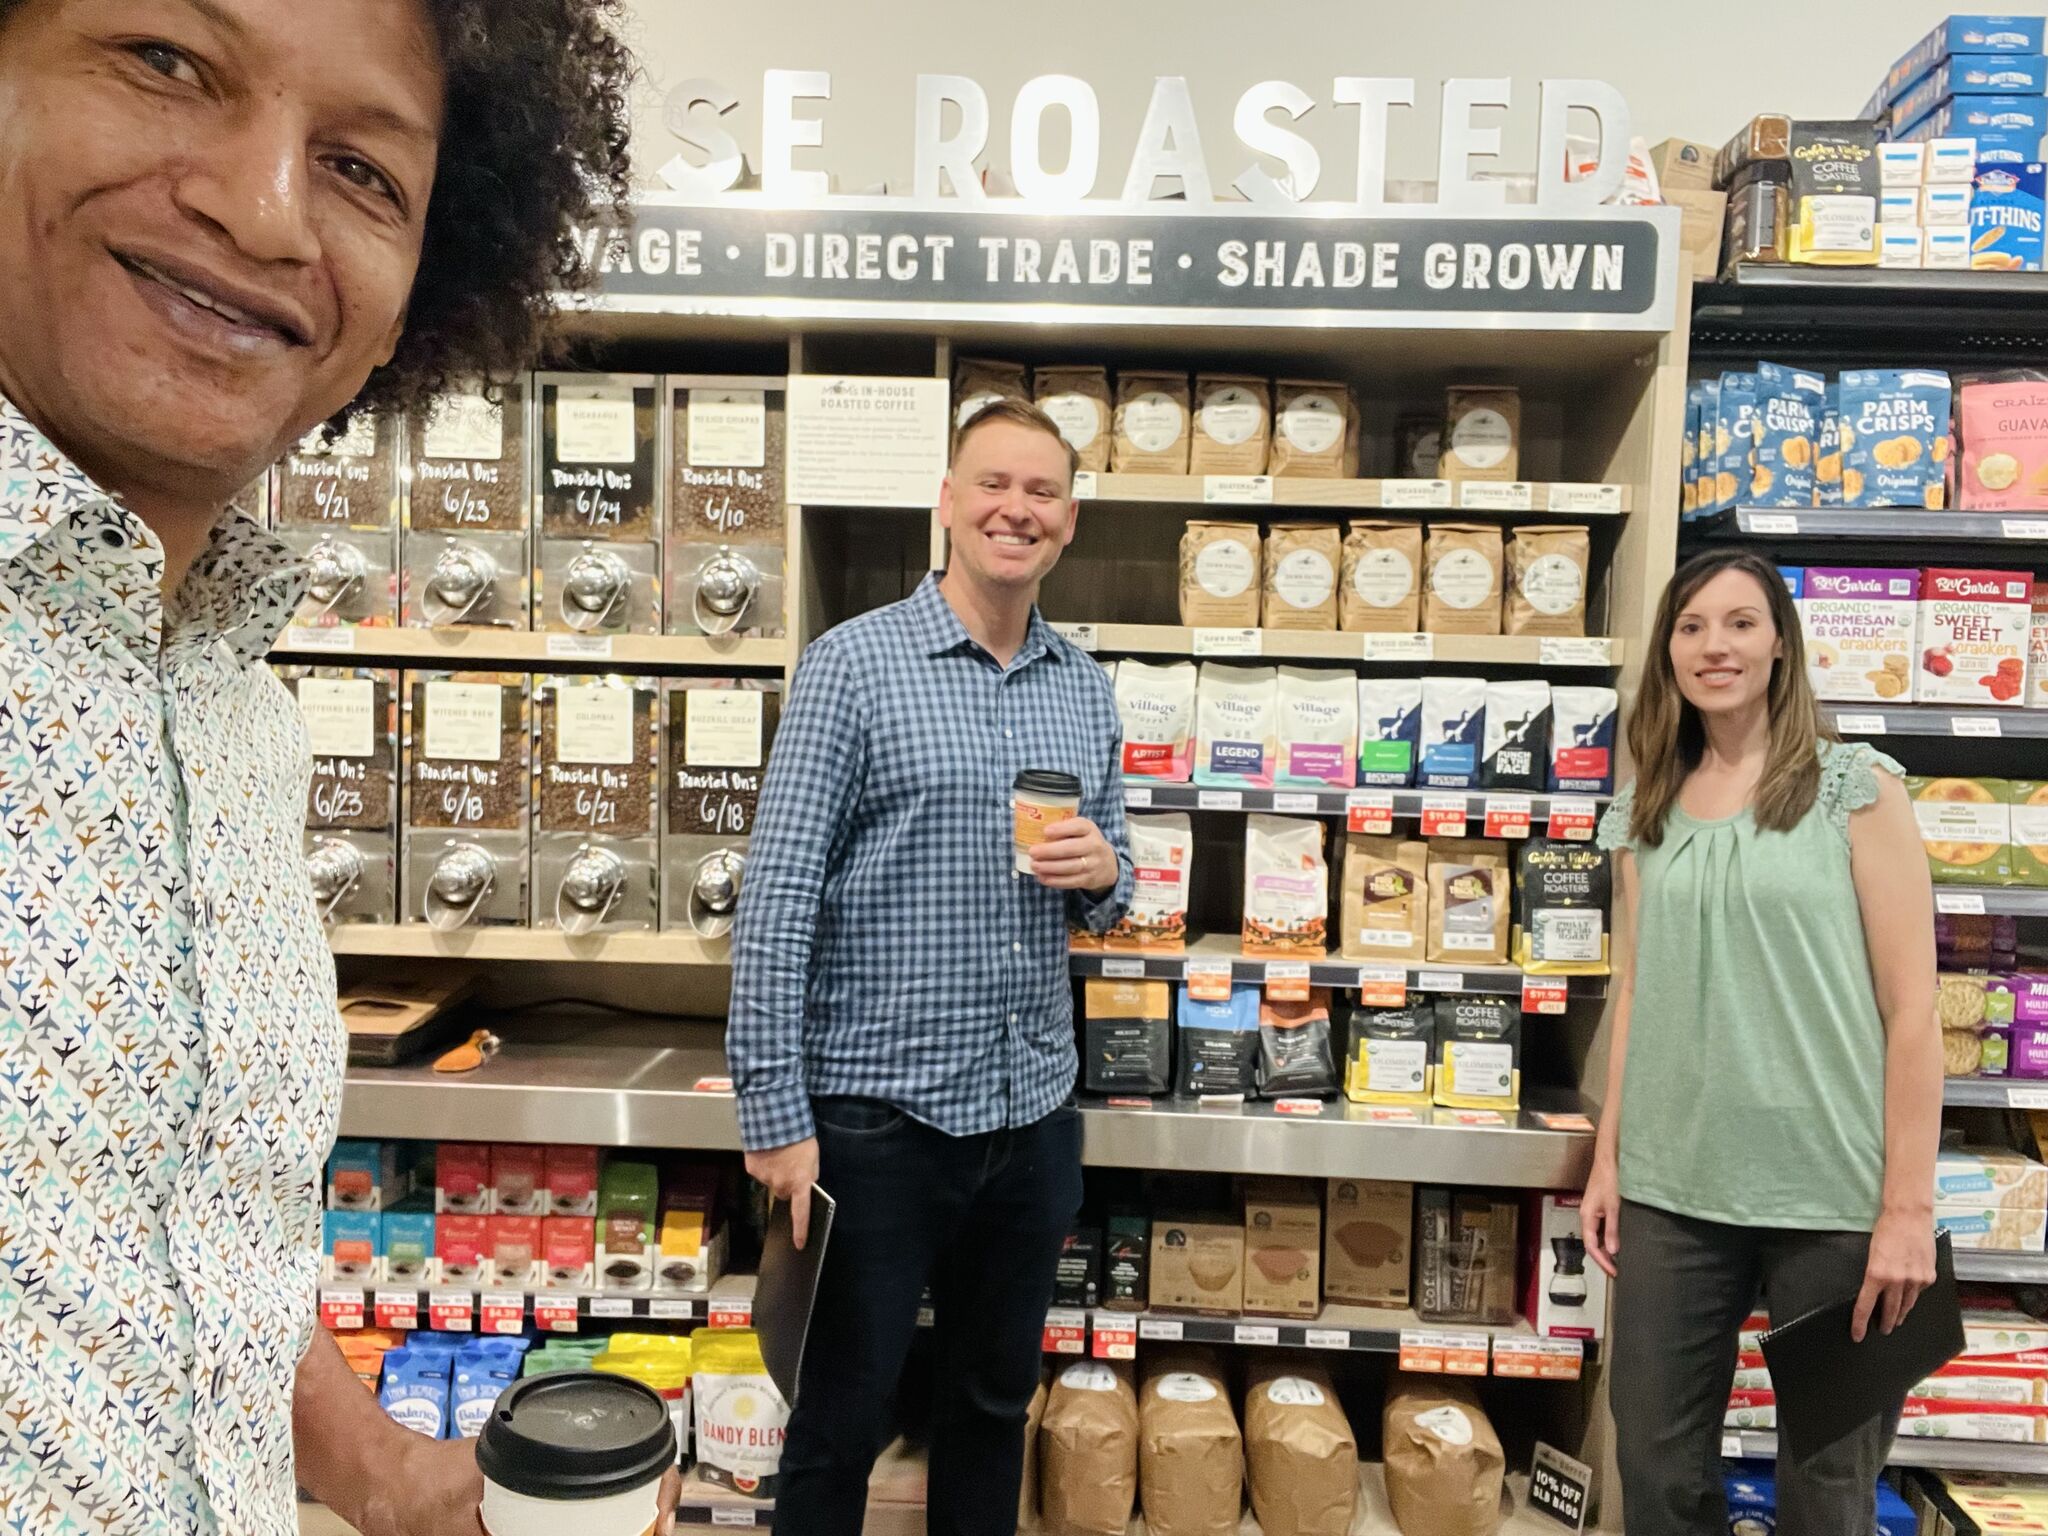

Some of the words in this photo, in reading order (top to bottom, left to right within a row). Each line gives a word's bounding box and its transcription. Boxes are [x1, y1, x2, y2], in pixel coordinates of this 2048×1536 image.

[914, 74, 1630, 204] ROASTED
[1812, 162, 1859, 174] COFFEE
[764, 231, 953, 281] DIRECT
[978, 237, 1153, 285] TRADE
[1217, 240, 1400, 288] SHADE
[1423, 242, 1625, 290] GROWN
[862, 386, 916, 398] IN-HOUSE
[820, 399, 871, 409] ROASTED
[875, 400, 917, 411] COFFEE
[1767, 398, 1810, 419] PARM
[1863, 399, 1928, 417] PARM
[1766, 414, 1814, 435] CRISPS
[1856, 414, 1935, 434] CRISPS
[419, 460, 470, 480] Roasted
[552, 467, 605, 489] Roasted
[682, 467, 734, 487] Roasted
[315, 480, 350, 520] 6/21
[443, 485, 490, 523] 6/23
[576, 488, 621, 526] 6/24
[705, 495, 745, 533] 6/10
[1810, 602, 1870, 614] ORGANIC
[1933, 602, 1990, 614] ORGANIC
[1810, 614, 1895, 626] PARMESAN
[1934, 614, 1992, 628] SWEET
[1815, 627, 1826, 637] &
[1829, 626, 1885, 638] GARLIC
[1953, 627, 2002, 641] BEET
[1839, 638, 1907, 651] crackers
[1955, 640, 2017, 656] crackers
[1130, 699, 1177, 714] village
[1215, 700, 1261, 715] village
[1292, 702, 1341, 716] village
[1132, 749, 1167, 759] ARTIST
[1215, 746, 1260, 759] LEGEND
[417, 760, 468, 783] Roasted
[549, 764, 598, 786] Roasted
[1495, 764, 1530, 775] FACE
[677, 770, 729, 791] Roasted
[314, 782, 363, 824] 6/23
[442, 784, 483, 825] 6/18
[576, 788, 616, 826] 6/21
[700, 793, 744, 833] 6/18
[1528, 851, 1565, 865] Golden
[1567, 852, 1602, 866] Valley
[1140, 871, 1161, 880] PERU
[1543, 872, 1589, 884] COFFEE
[1544, 884, 1590, 894] ROASTERS
[1455, 1006, 1500, 1018] COFFEE
[1455, 1018, 1502, 1028] ROASTERS
[703, 1419, 744, 1445] DANDY
[1536, 1469, 1559, 1493] 10%
[1560, 1483, 1582, 1504] OFF
